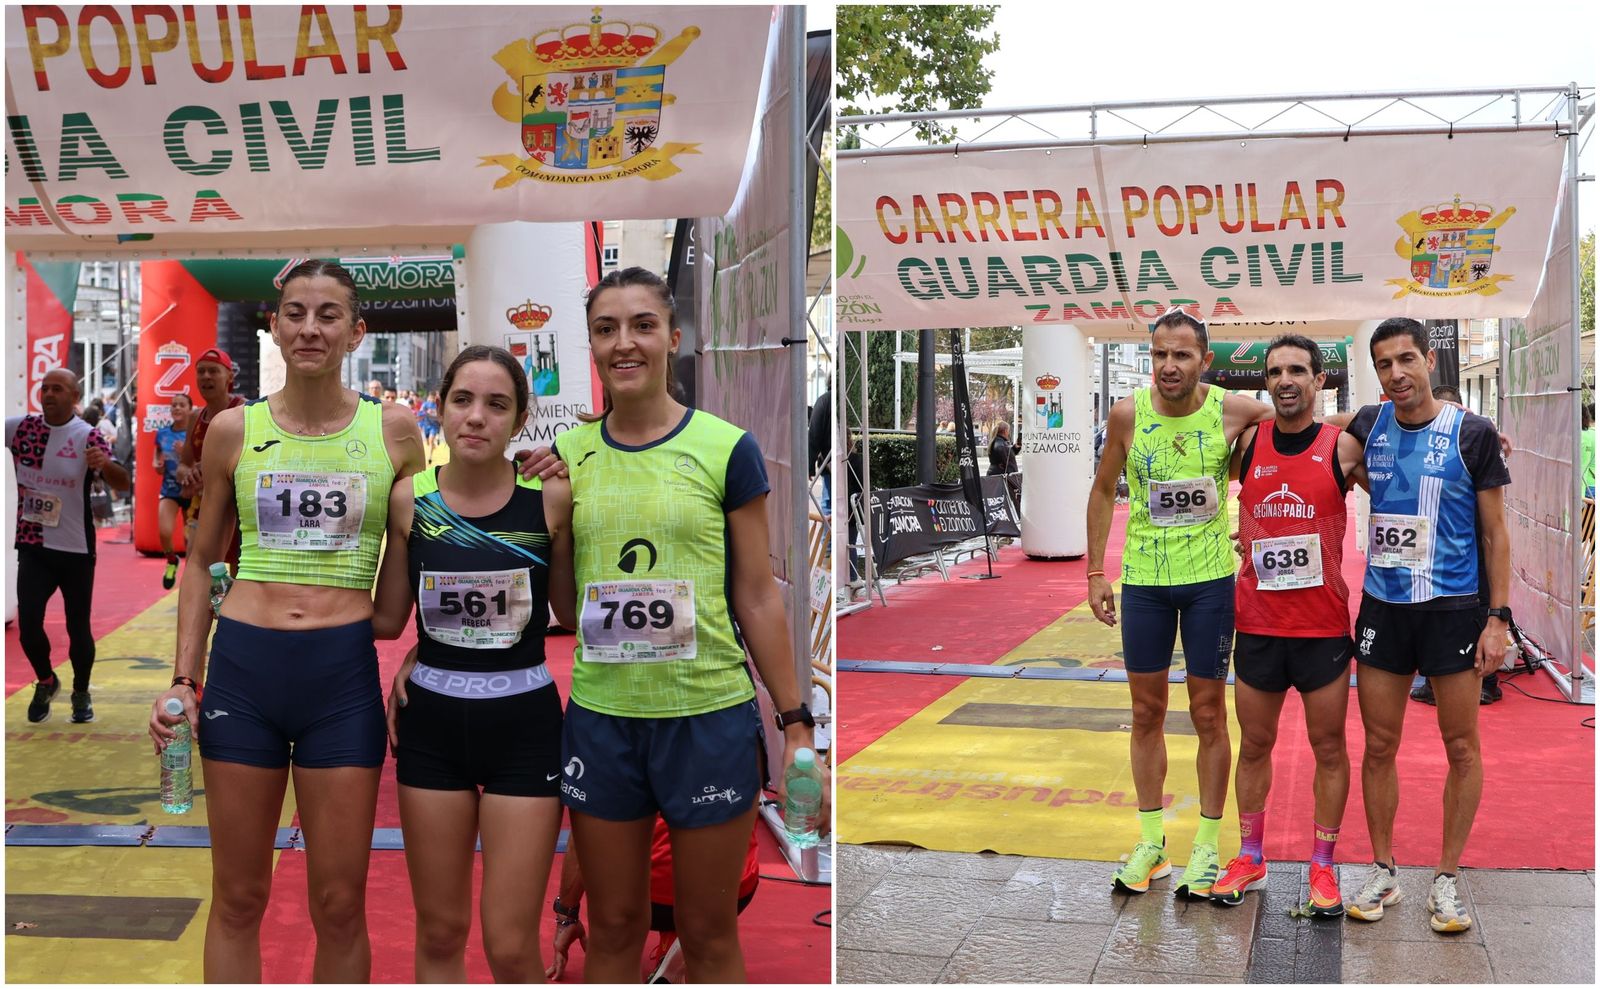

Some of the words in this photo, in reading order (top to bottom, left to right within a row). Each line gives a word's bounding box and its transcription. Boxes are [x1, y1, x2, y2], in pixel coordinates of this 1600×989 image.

[22, 5, 407, 91] POPULAR
[5, 112, 129, 183] IA
[163, 94, 440, 177] CIVIL
[515, 165, 595, 183] COMANDANCIA
[598, 173, 613, 181] DE
[616, 158, 661, 178] ZAMORA
[876, 187, 1105, 244] CARRERA
[1121, 178, 1346, 239] POPULAR
[897, 249, 1179, 301] GUARDIA
[1201, 241, 1364, 290] CIVIL
[1032, 443, 1081, 454] ZAMORA
[30, 497, 54, 512] 199
[276, 489, 347, 518] 183
[1160, 490, 1207, 509] 596
[300, 519, 320, 528] LARA
[890, 515, 923, 535] ZAMORA
[1375, 526, 1417, 548] 562
[1263, 548, 1309, 570] 638
[440, 590, 507, 618] 561
[600, 599, 674, 630] 769
[462, 618, 492, 628] REBECA
[444, 674, 512, 694] PRO
